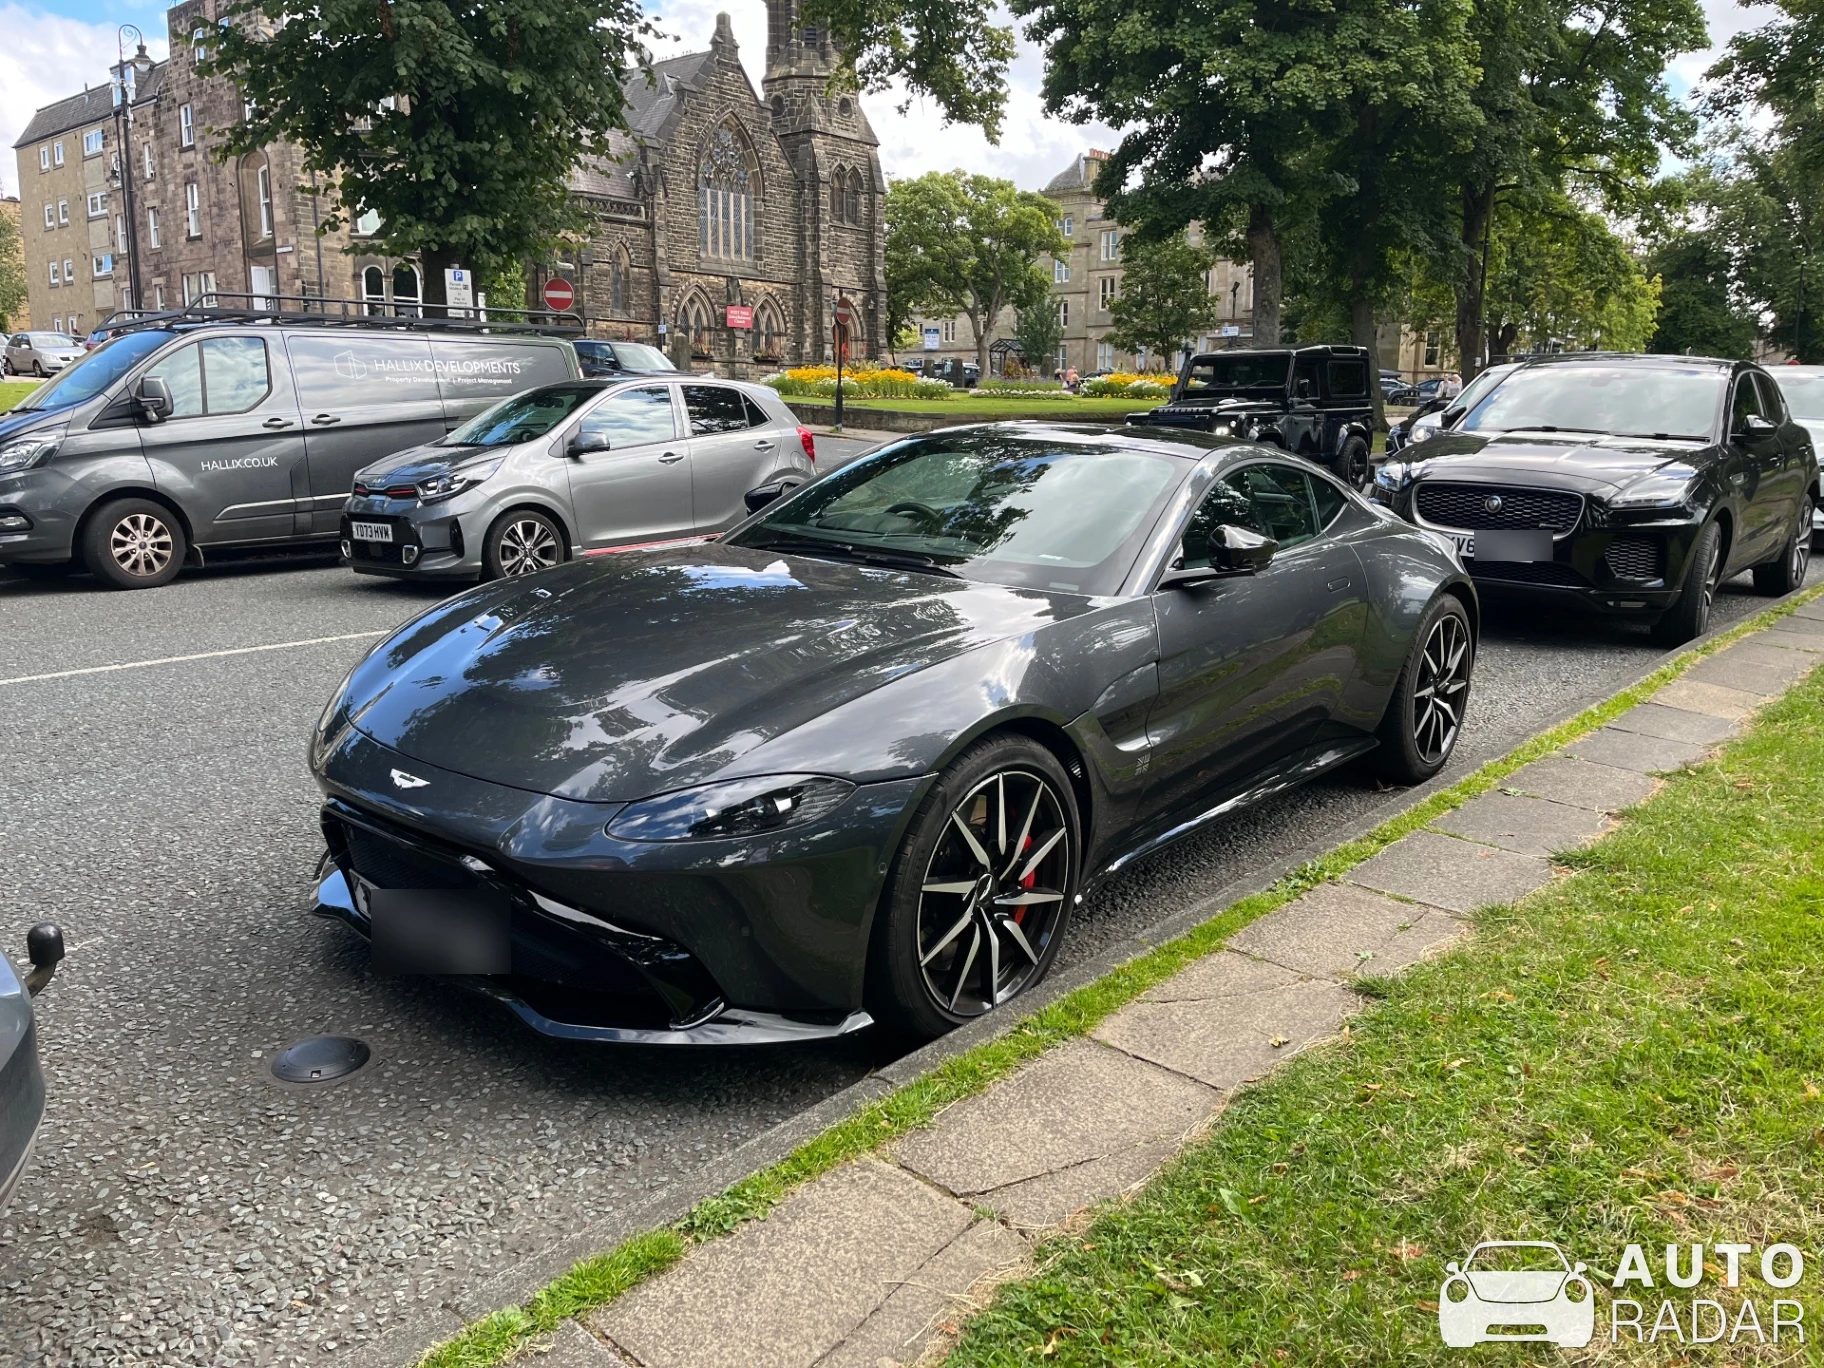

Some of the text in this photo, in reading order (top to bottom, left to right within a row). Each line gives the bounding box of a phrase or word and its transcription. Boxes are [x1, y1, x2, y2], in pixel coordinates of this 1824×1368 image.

[373, 359, 521, 374] HALLIX DEVELOPMENTS
[385, 376, 512, 385] Property Development Project Management
[200, 456, 279, 471] HALLIX.CO.UK
